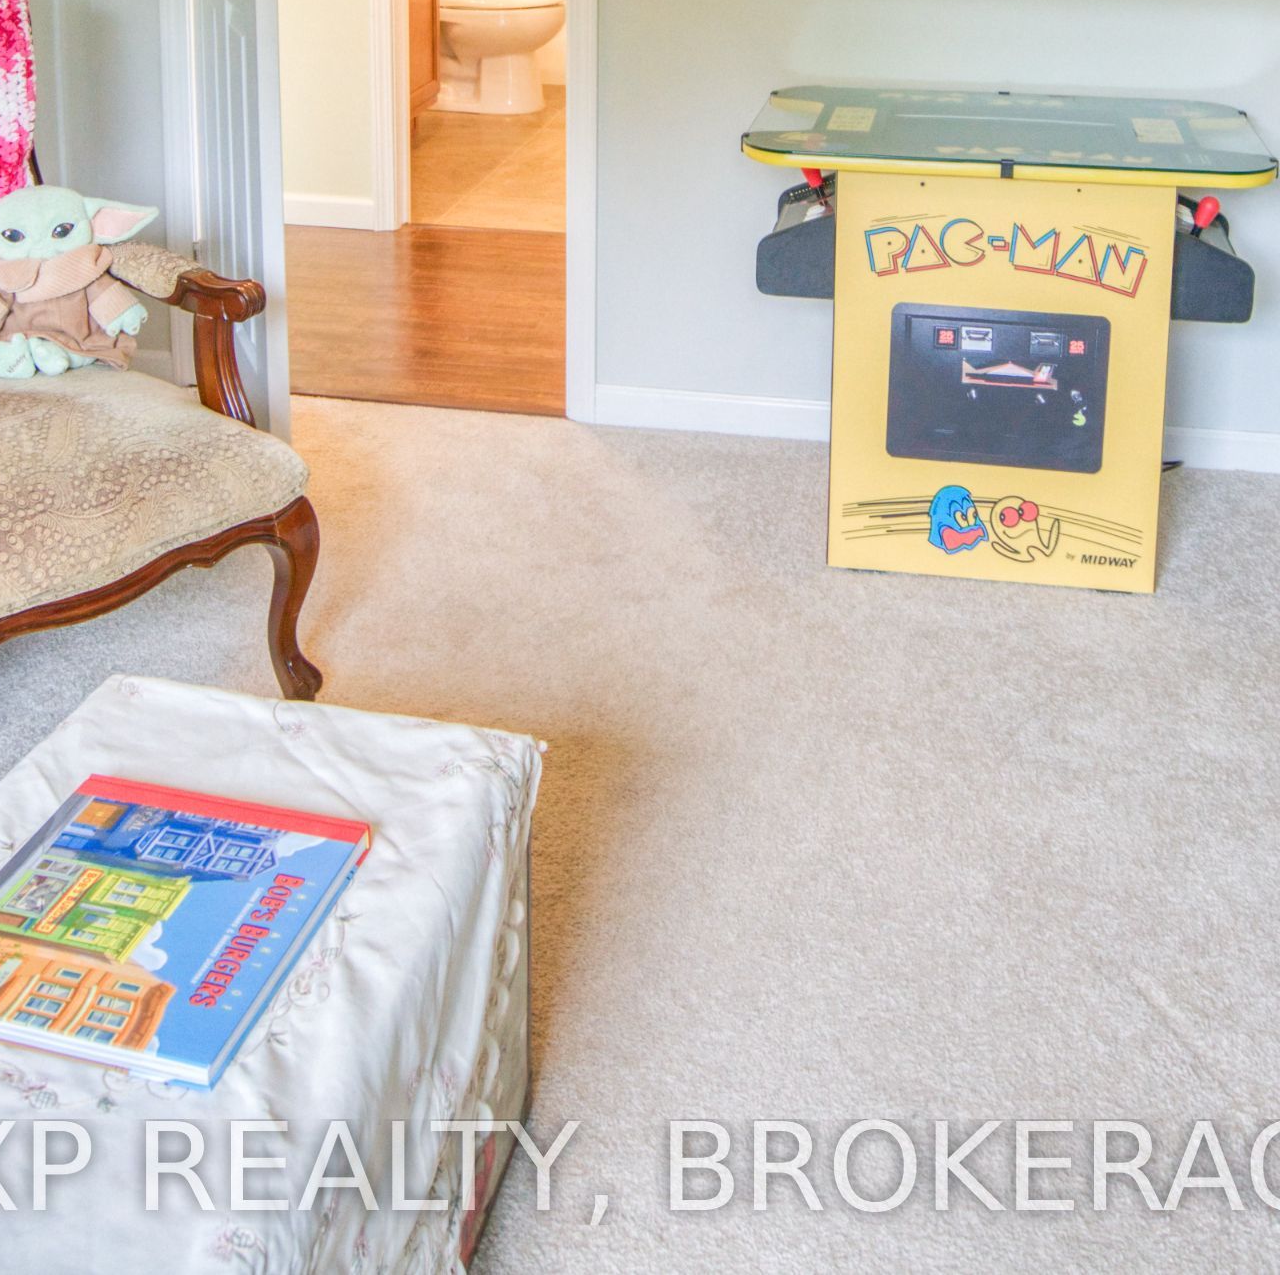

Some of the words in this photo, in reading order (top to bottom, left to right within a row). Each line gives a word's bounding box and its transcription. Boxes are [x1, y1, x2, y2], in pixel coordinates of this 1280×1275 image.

[864, 218, 1148, 299] PAC-MAN
[1080, 554, 1138, 568] MIDWAY
[250, 873, 306, 922] BOB'S
[189, 923, 270, 1008] BURGERS
